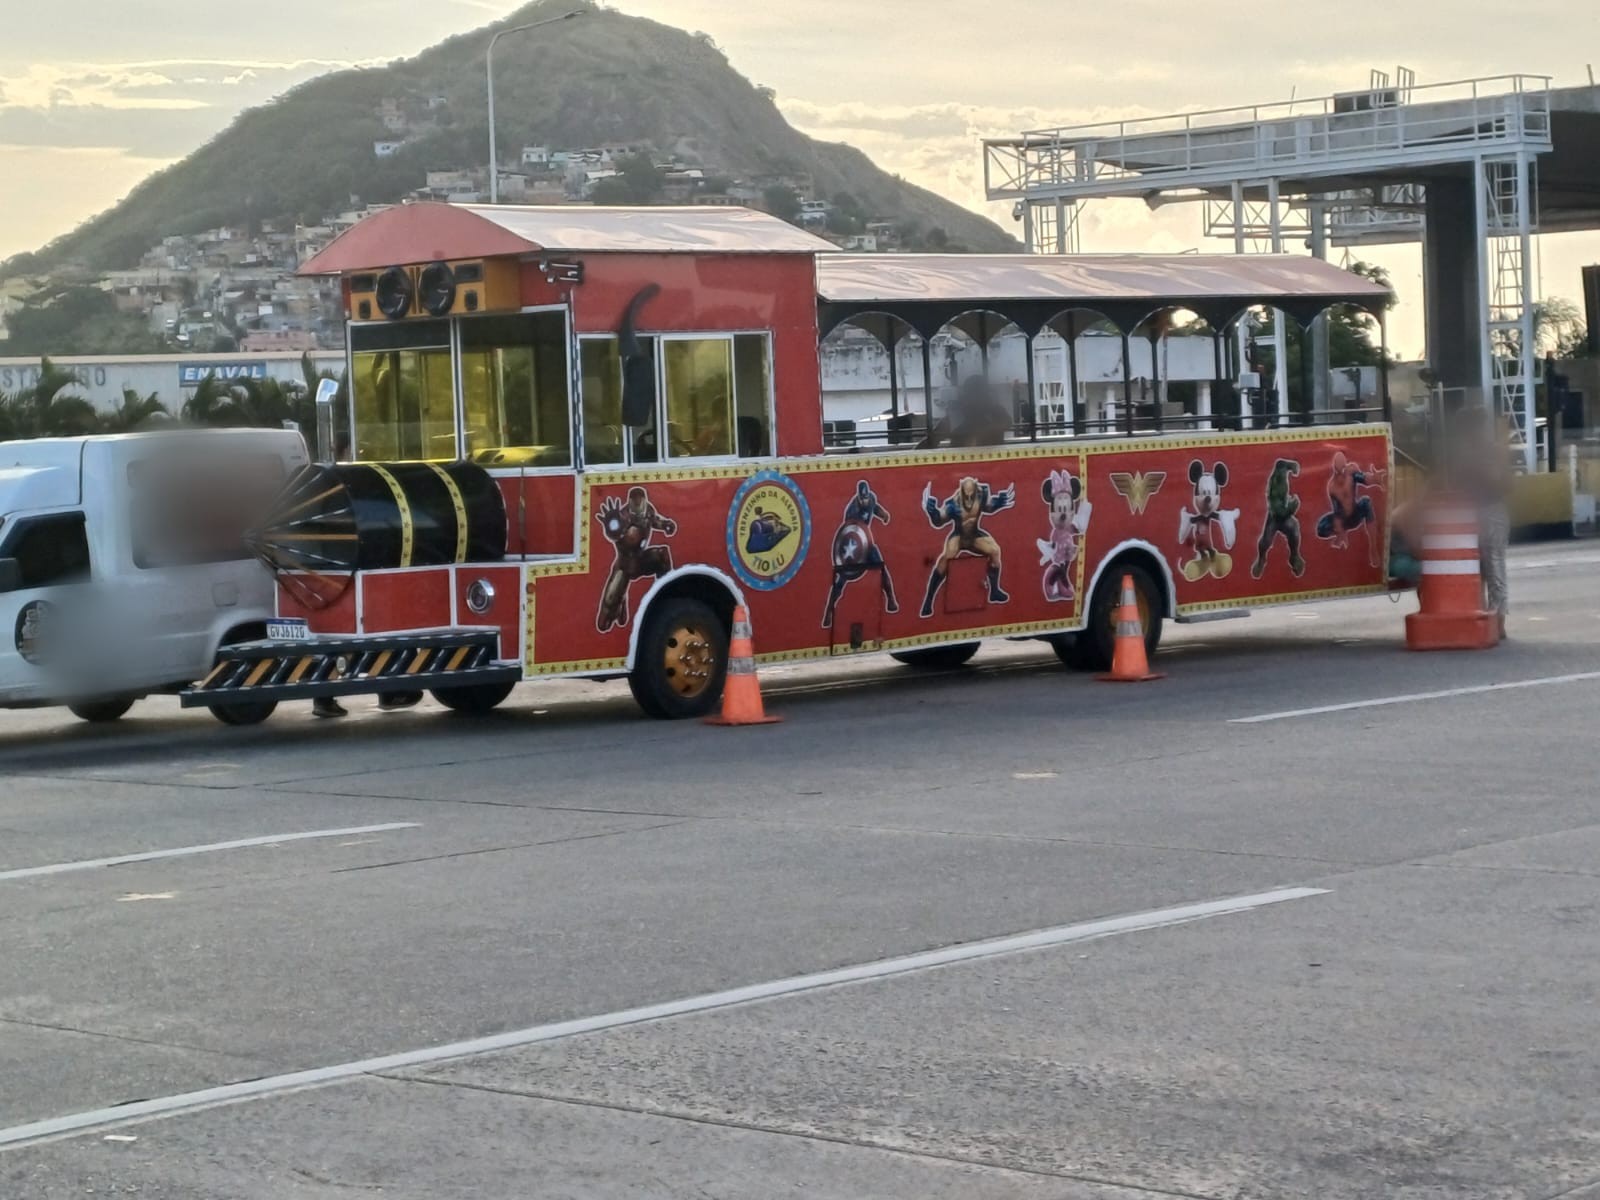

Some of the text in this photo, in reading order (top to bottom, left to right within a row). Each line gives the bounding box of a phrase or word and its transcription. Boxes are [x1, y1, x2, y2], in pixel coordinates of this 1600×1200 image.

[184, 366, 262, 380] ENAVAL
[740, 490, 799, 536] TRENZINHO DA ALEGRIA
[752, 554, 785, 571] TIO LU
